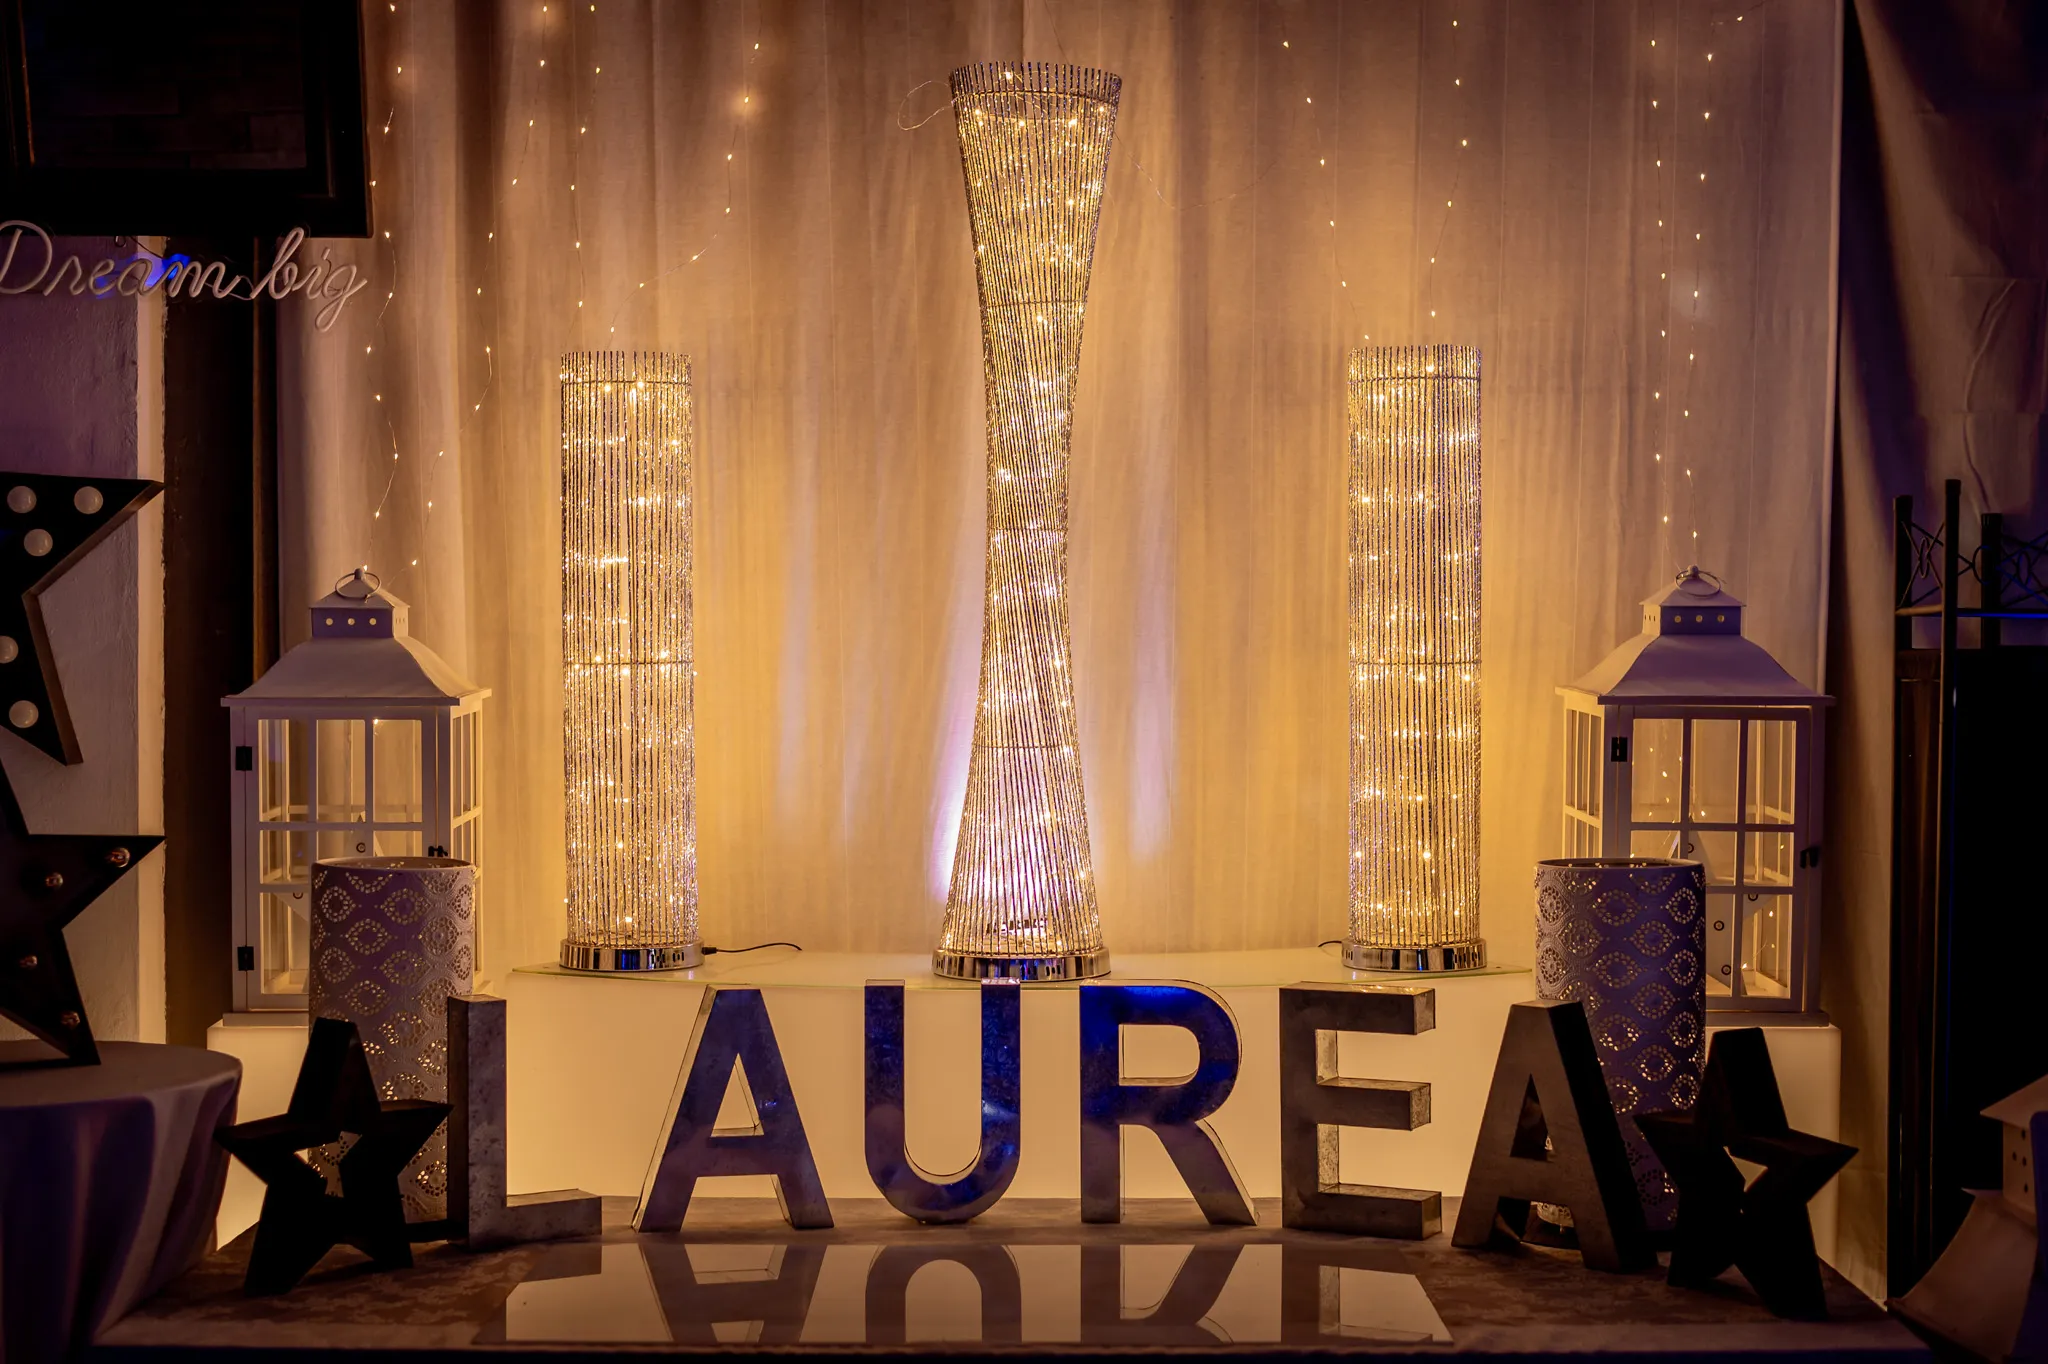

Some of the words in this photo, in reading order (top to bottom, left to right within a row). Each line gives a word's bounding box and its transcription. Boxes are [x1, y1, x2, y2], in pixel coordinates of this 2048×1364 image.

[0, 220, 241, 298] Dream
[250, 227, 367, 332] big
[448, 979, 1658, 1272] LAUREA
